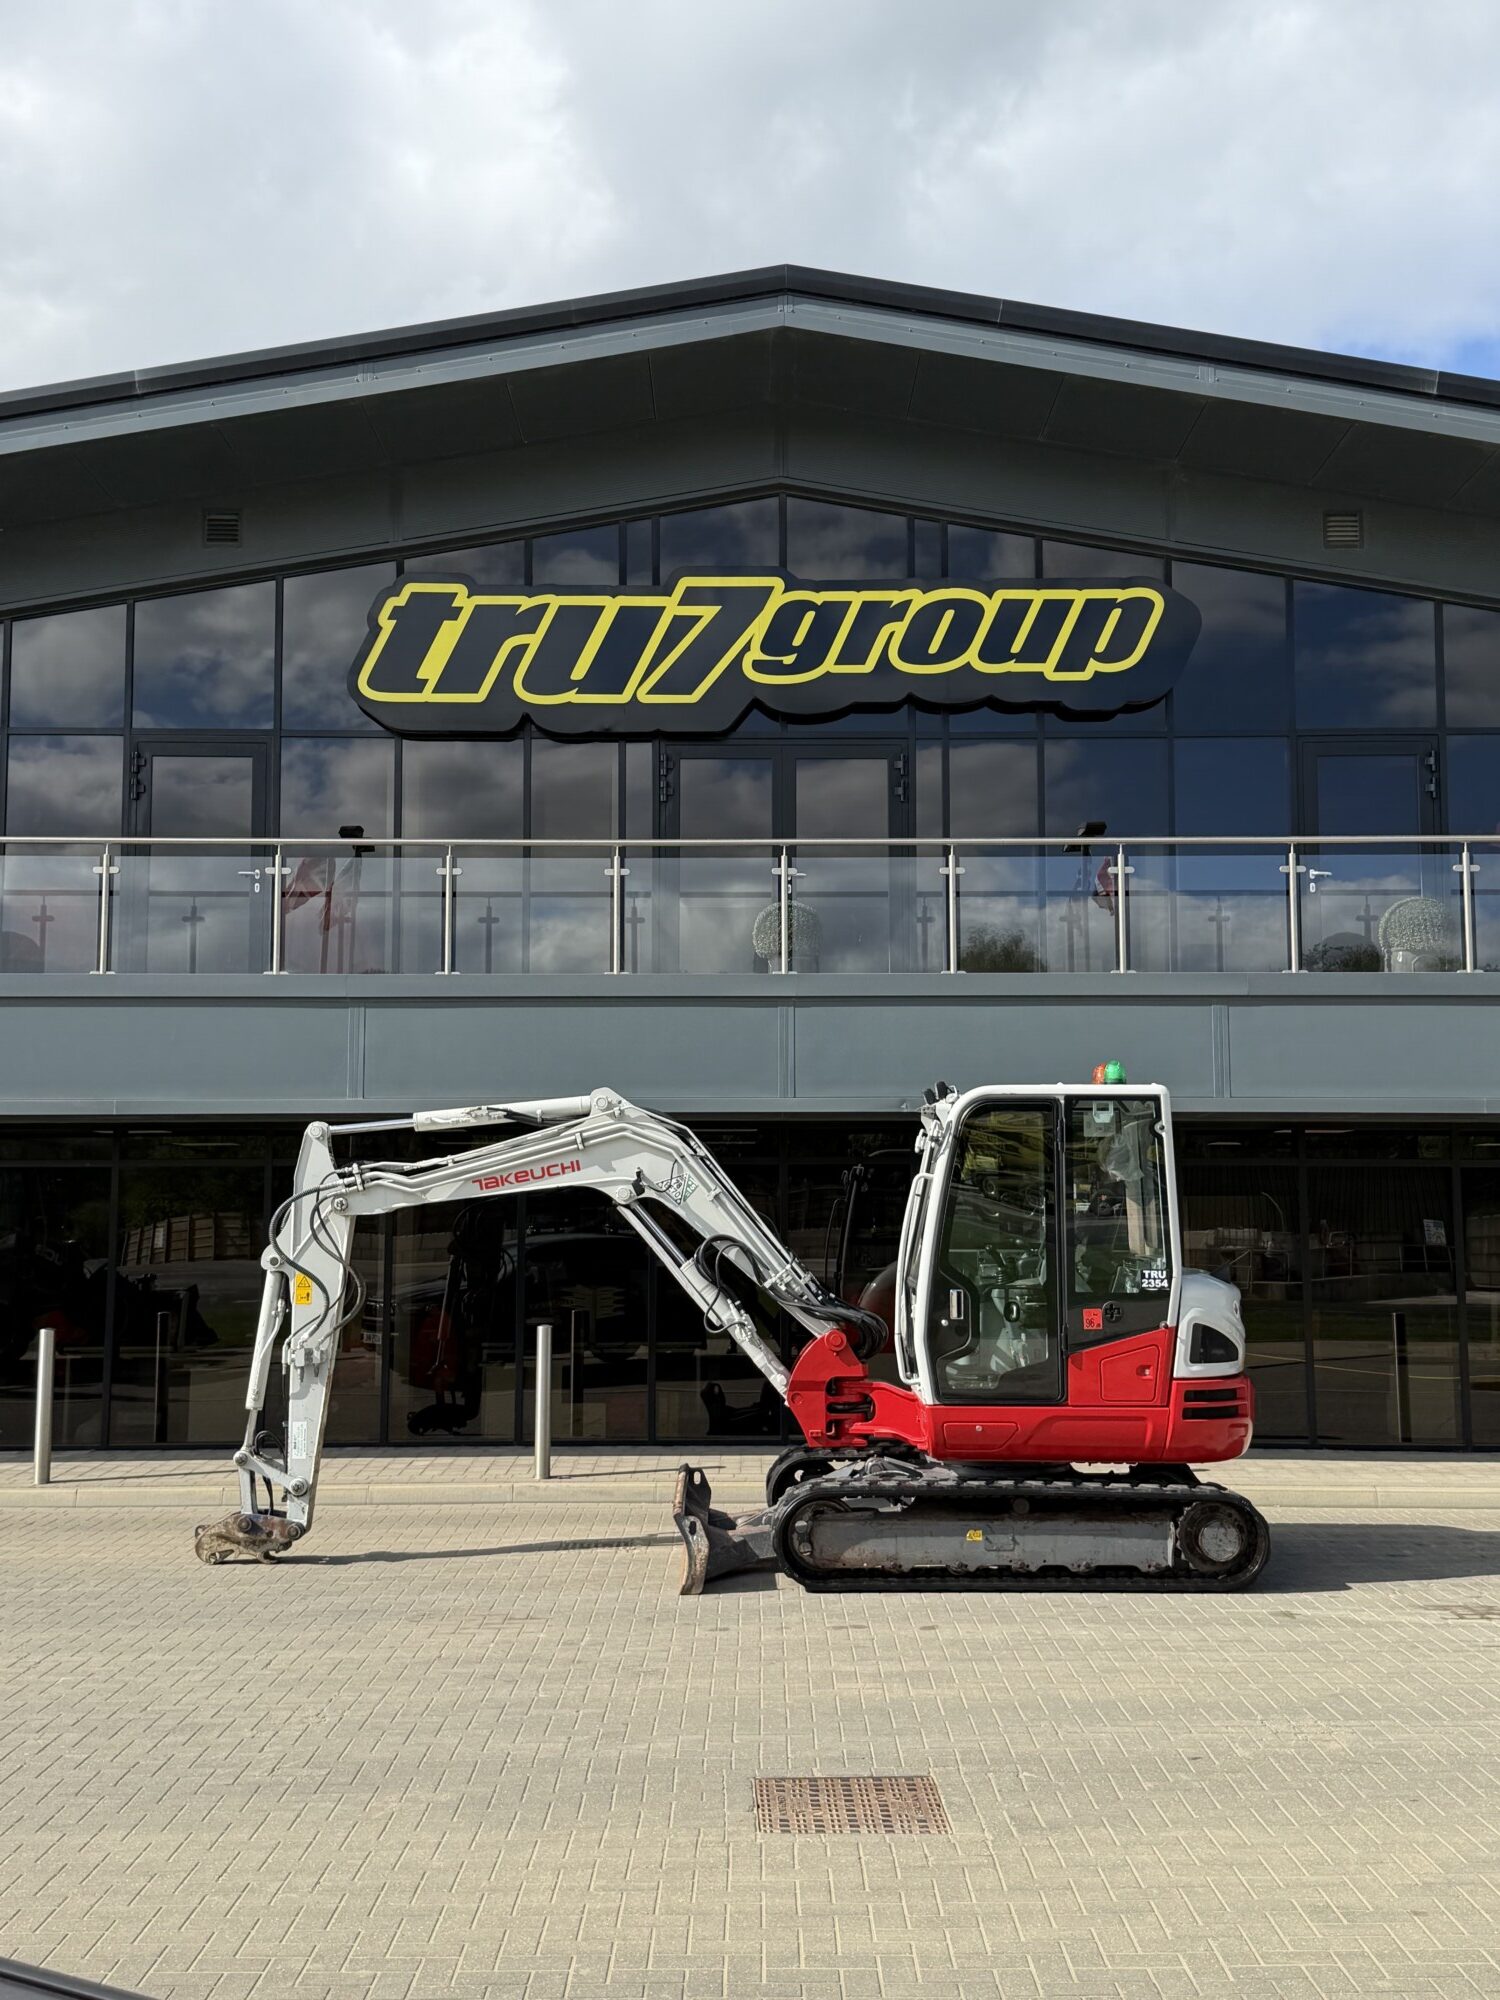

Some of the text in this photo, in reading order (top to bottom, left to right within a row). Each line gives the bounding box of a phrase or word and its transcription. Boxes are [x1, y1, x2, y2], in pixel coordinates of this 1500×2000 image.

[357, 576, 1164, 704] tru7group
[472, 1160, 581, 1190] TAKEUCHI
[1141, 1279, 1169, 1288] 2354
[1142, 1270, 1167, 1279] TRU
